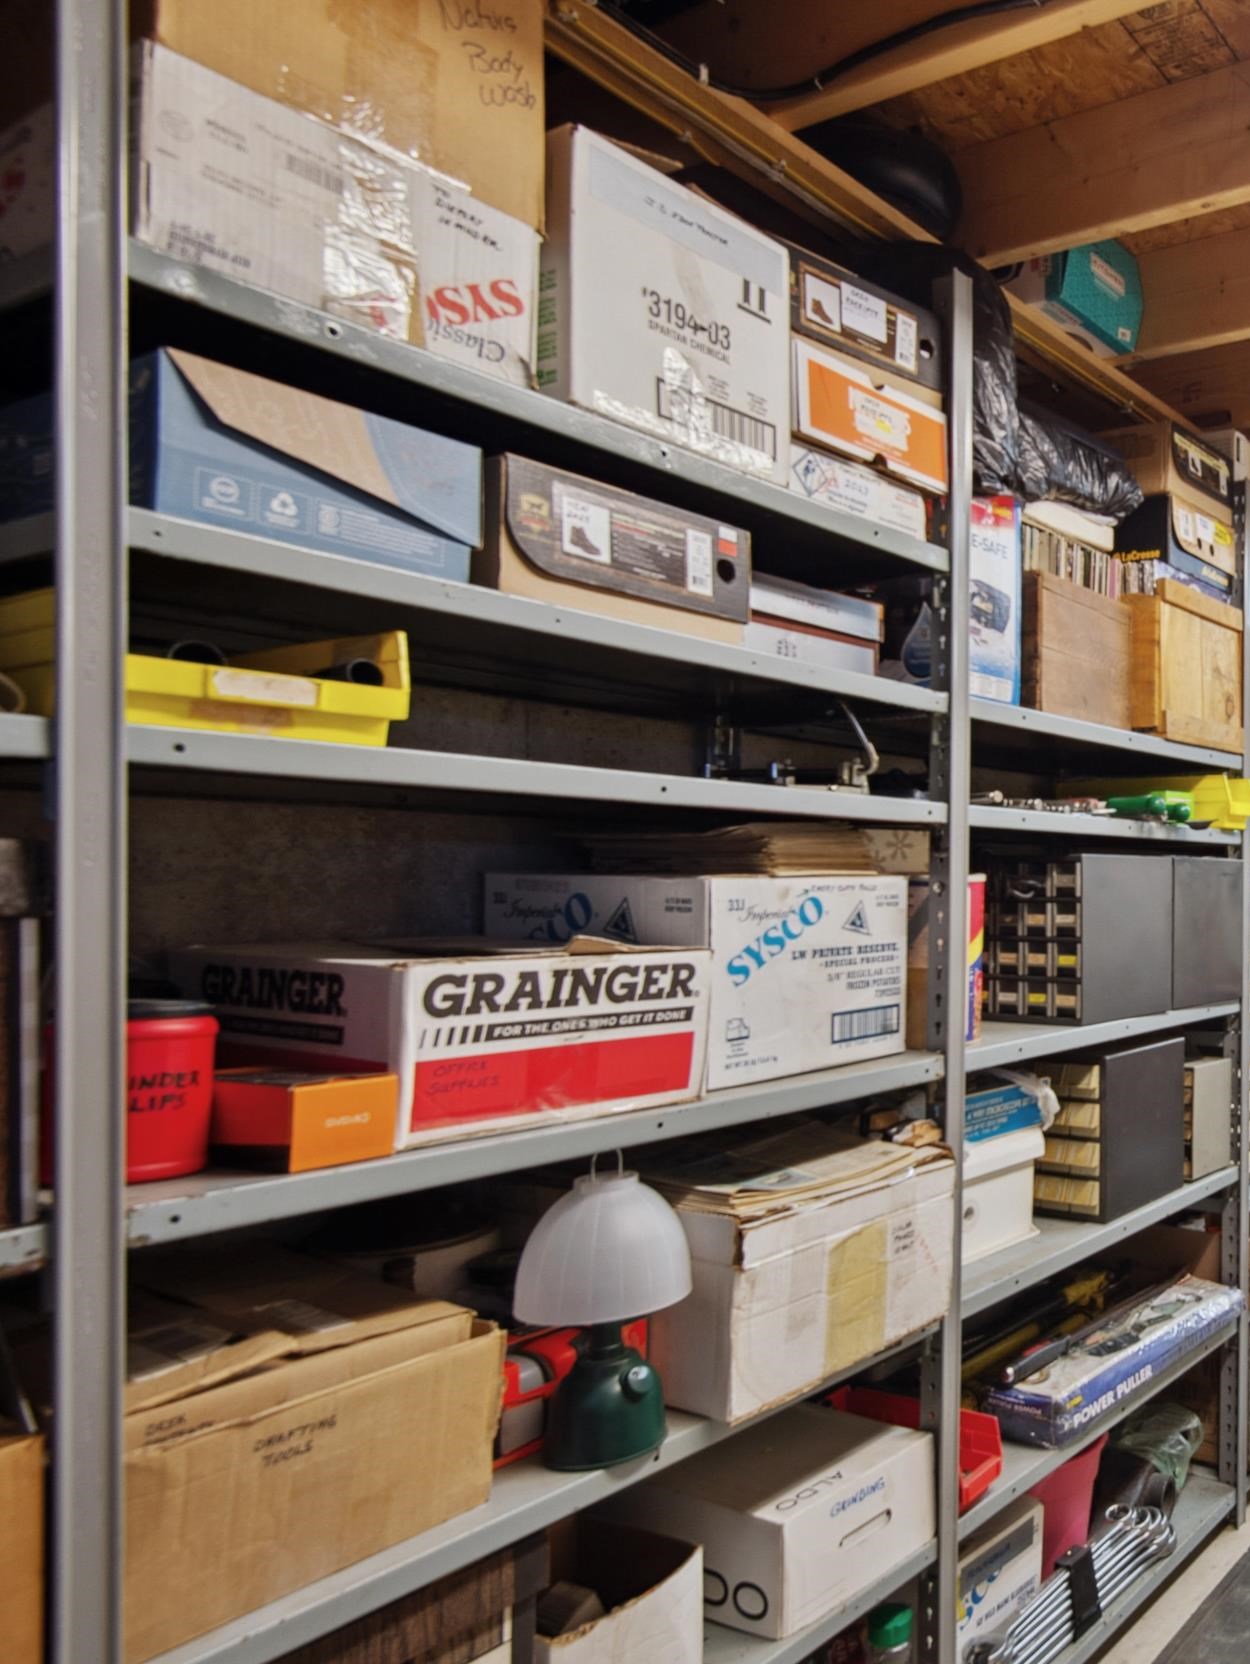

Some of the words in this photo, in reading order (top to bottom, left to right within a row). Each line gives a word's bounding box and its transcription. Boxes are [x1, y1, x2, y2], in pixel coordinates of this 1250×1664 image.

[461, 41, 524, 83] Body
[479, 80, 537, 111] Wash
[426, 279, 525, 326] SYS
[648, 318, 688, 346] SPARTAN
[689, 337, 731, 366] CHEMICAL
[726, 894, 824, 988] SYSCO
[203, 963, 345, 1016] GRAINGER
[423, 962, 697, 1019] GRAINGER
[493, 1025, 522, 1039] FOR
[523, 1022, 549, 1035] THE
[550, 1018, 587, 1033] ONES
[588, 1015, 616, 1030] WHO
[618, 1013, 642, 1026] GET
[642, 1012, 655, 1024] IT
[656, 1009, 687, 1023] DONE
[130, 1070, 200, 1091] INDER
[129, 1093, 187, 1113] LIPS
[1072, 1391, 1116, 1430] POWER
[1116, 1363, 1153, 1400] PULLER
[829, 1476, 887, 1518] GRINDING
